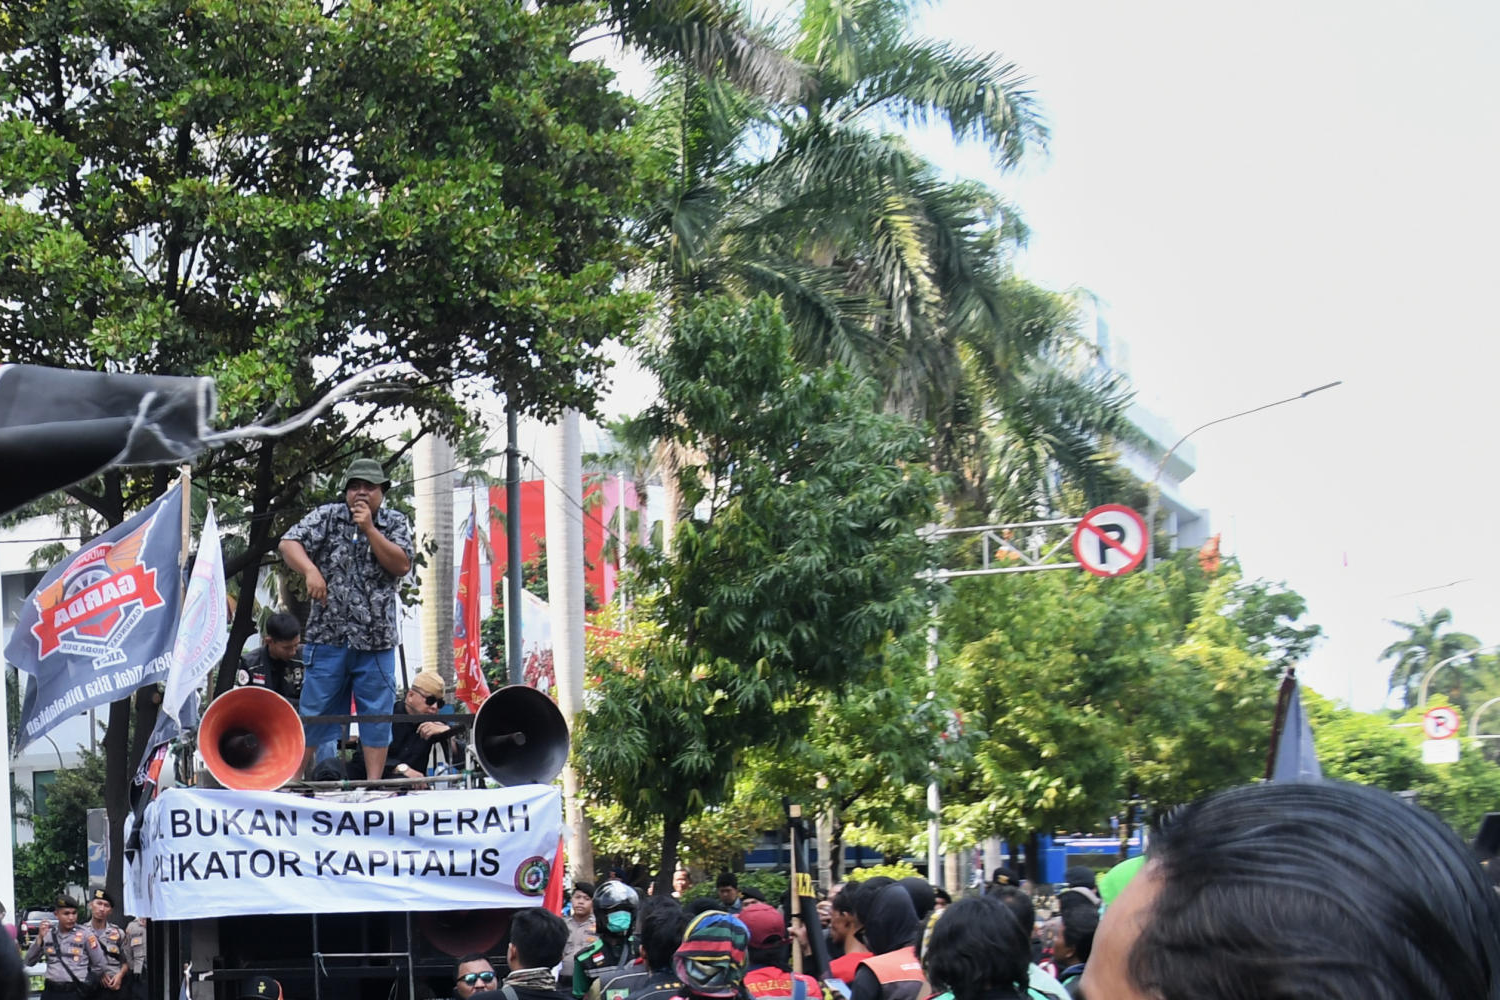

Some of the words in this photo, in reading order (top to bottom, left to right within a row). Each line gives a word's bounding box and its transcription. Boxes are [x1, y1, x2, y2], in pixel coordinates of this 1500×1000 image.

[171, 808, 298, 838] BUKAN
[311, 810, 395, 837] SAPI
[409, 804, 530, 837] PERAH
[315, 848, 500, 878] KAPITALIS
